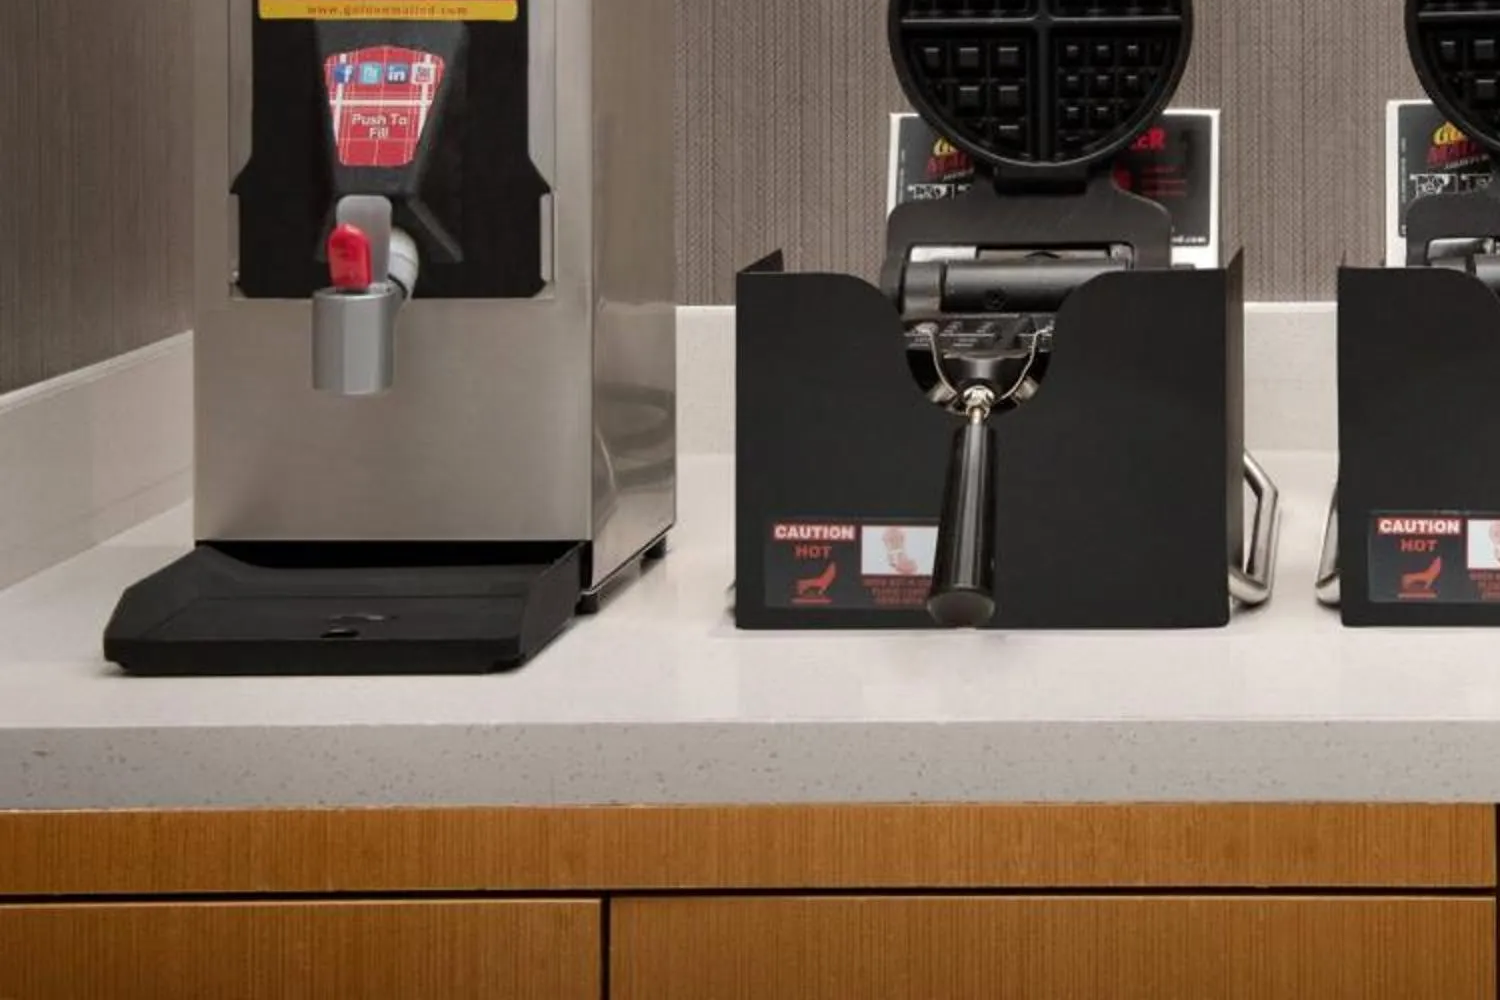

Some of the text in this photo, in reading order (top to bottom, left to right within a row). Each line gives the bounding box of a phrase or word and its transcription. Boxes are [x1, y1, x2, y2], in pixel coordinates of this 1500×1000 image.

[351, 113, 408, 126] Push To
[369, 127, 389, 139] Fill
[773, 524, 855, 540] CAUTION
[1379, 518, 1461, 534] CAUTION
[795, 545, 832, 559] HOT
[1400, 538, 1438, 552] HOT
